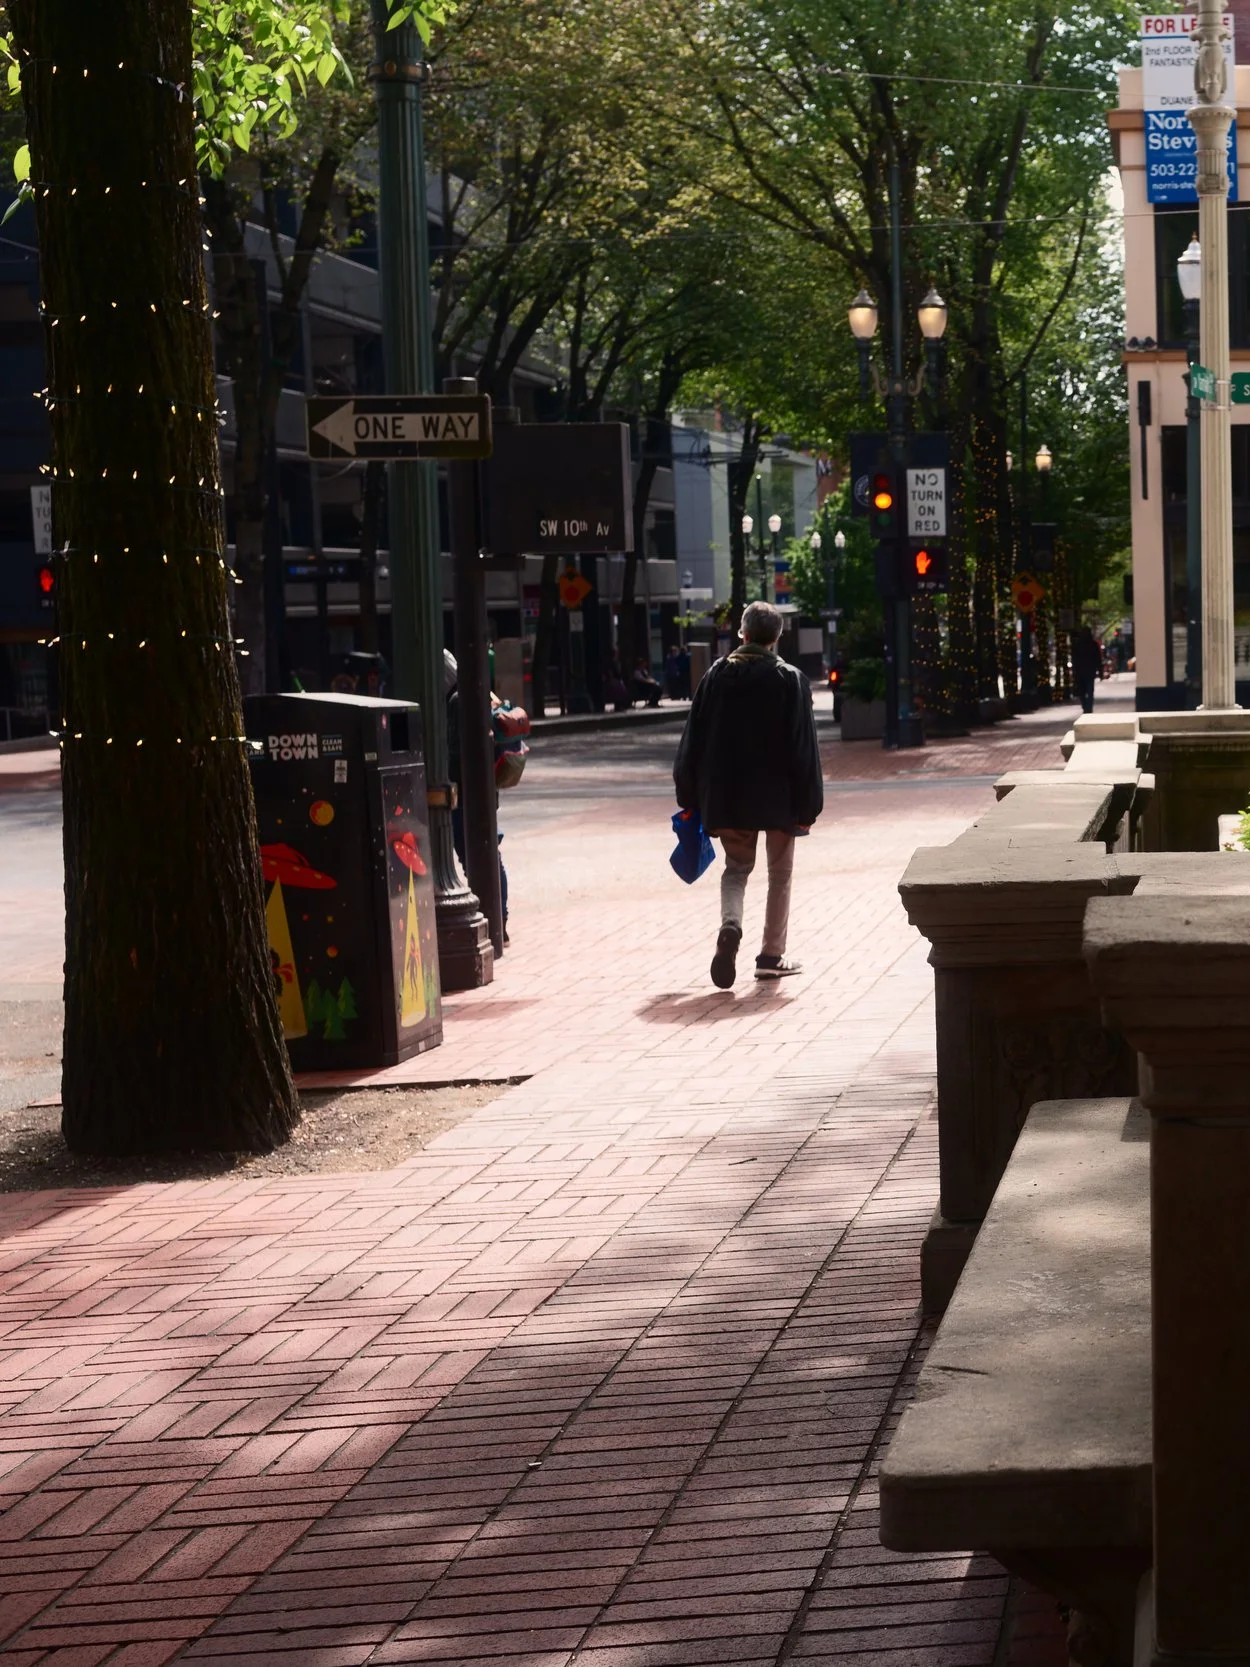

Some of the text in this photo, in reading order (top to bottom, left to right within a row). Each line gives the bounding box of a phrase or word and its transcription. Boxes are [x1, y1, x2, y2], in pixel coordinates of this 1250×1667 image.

[1145, 17, 1230, 32] FOR LEE
[1163, 46, 1192, 55] FLOOR
[1150, 58, 1195, 67] FANTASTIC
[1160, 97, 1194, 105] DUANE
[1148, 133, 1233, 150] Stevs
[355, 415, 475, 439] ONE WAY
[915, 473, 938, 486] NO
[40, 491, 50, 503] N
[911, 490, 943, 501] TURN
[35, 507, 51, 518] TU
[918, 505, 936, 516] ON
[540, 519, 610, 537] SW 10th Av
[915, 520, 940, 532] RED
[268, 733, 318, 748] DOWN
[269, 747, 319, 761] TOWN
